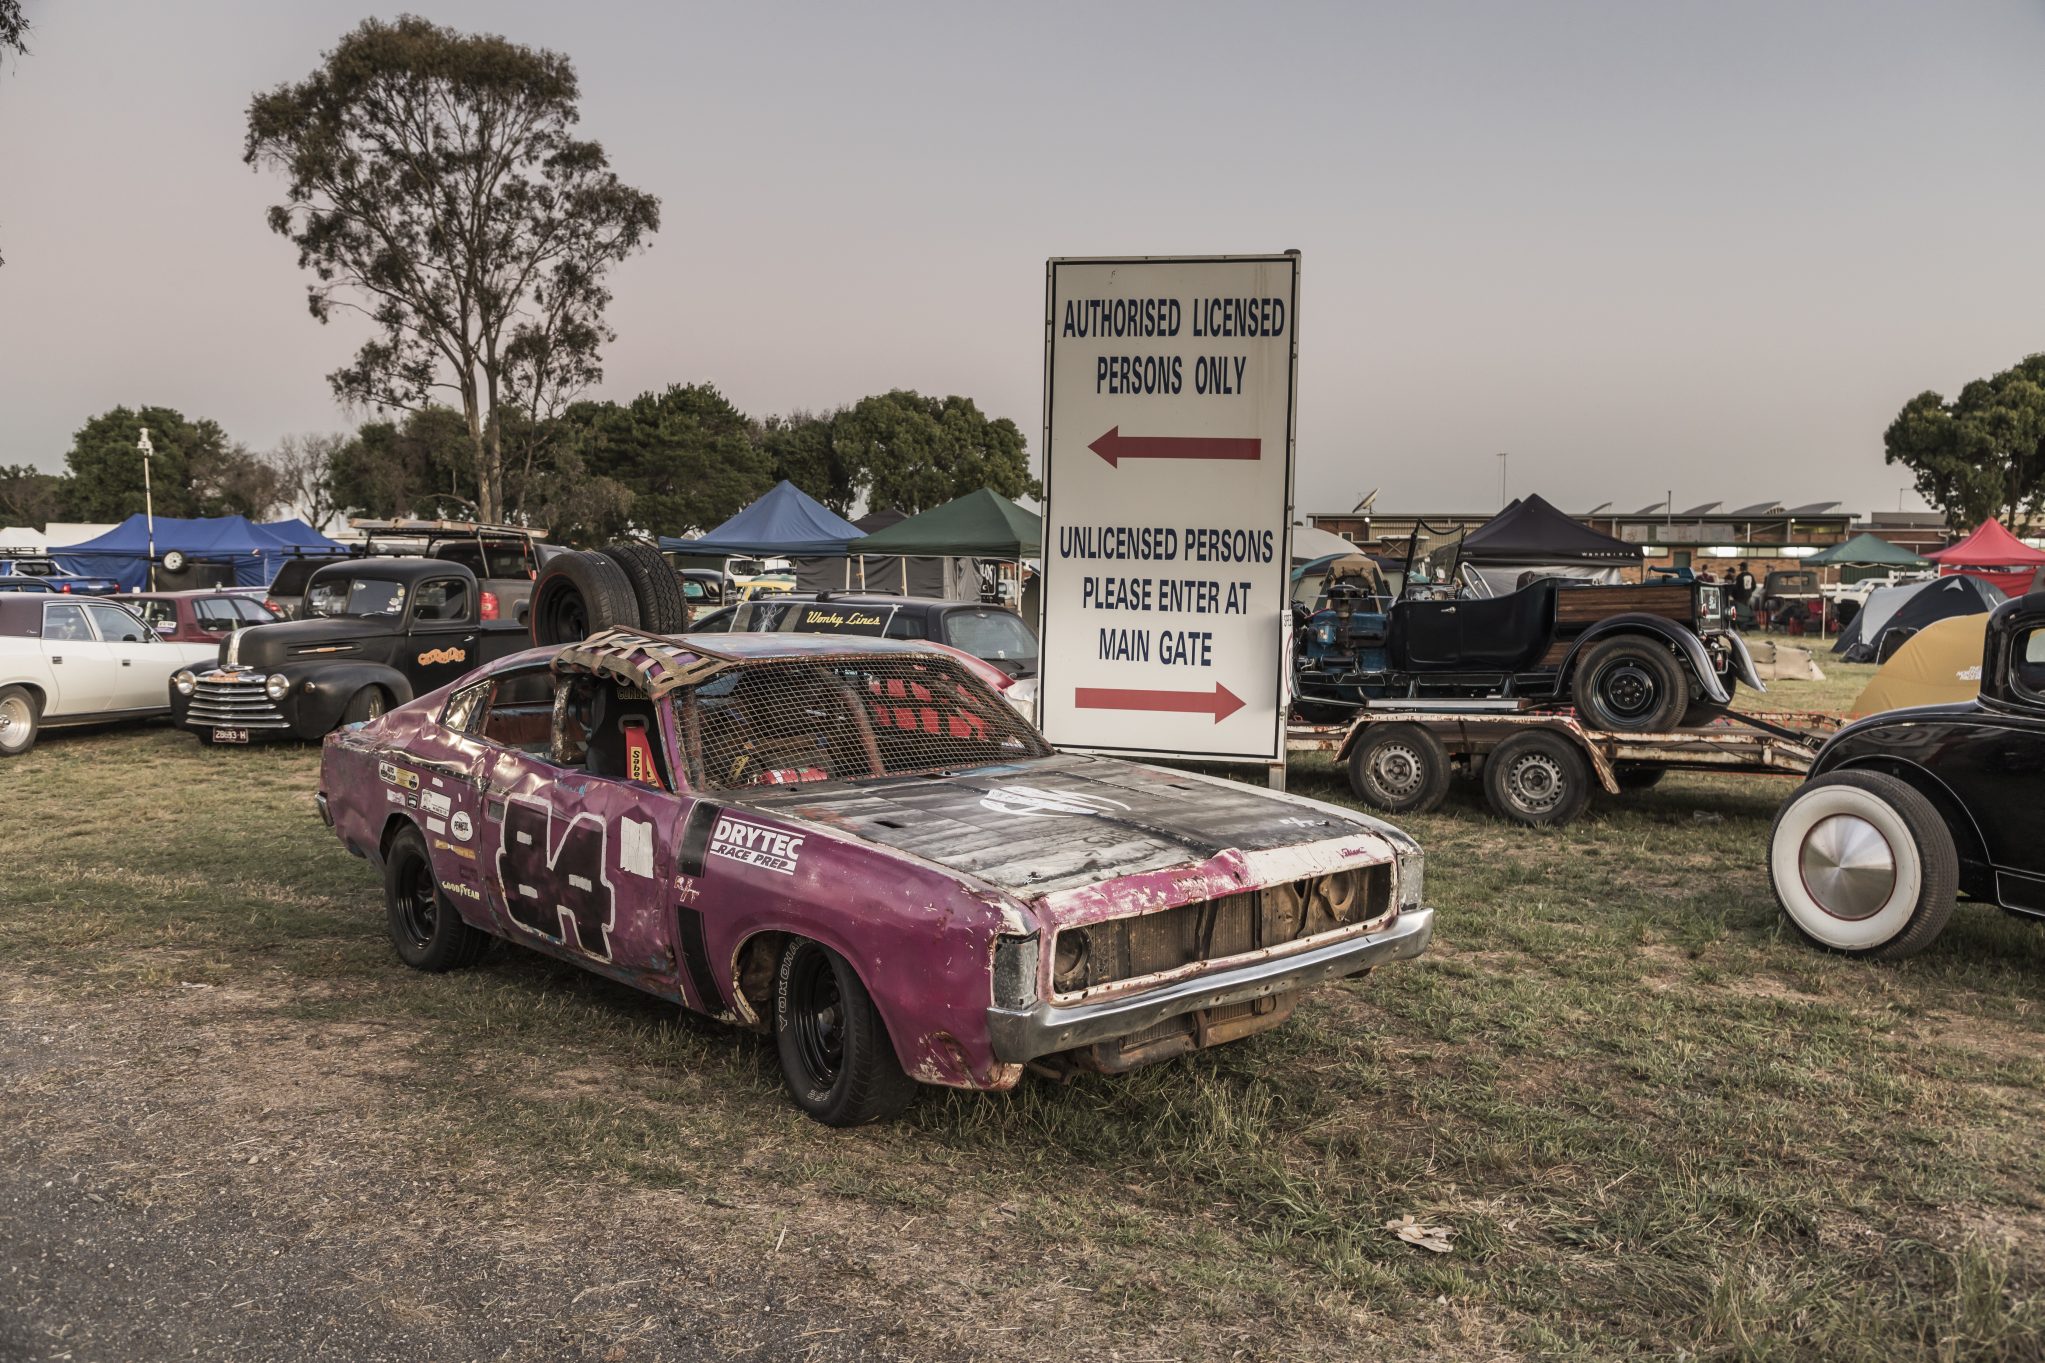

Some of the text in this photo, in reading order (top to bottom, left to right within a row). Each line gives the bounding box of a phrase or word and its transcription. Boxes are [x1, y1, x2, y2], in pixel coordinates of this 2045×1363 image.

[1063, 298, 1285, 338] AUTHORISED LICENSED
[1096, 355, 1247, 395] PERSONS ONLY
[1060, 525, 1274, 563] UNLICENSED PERSONS
[1083, 576, 1252, 615] PLEASE ENTER AT
[845, 612, 881, 625] Lines
[1098, 628, 1213, 667] MAIN GATE
[633, 750, 641, 780] Sabe
[713, 820, 804, 861] DRYTEC
[716, 844, 789, 870] RACE PREP
